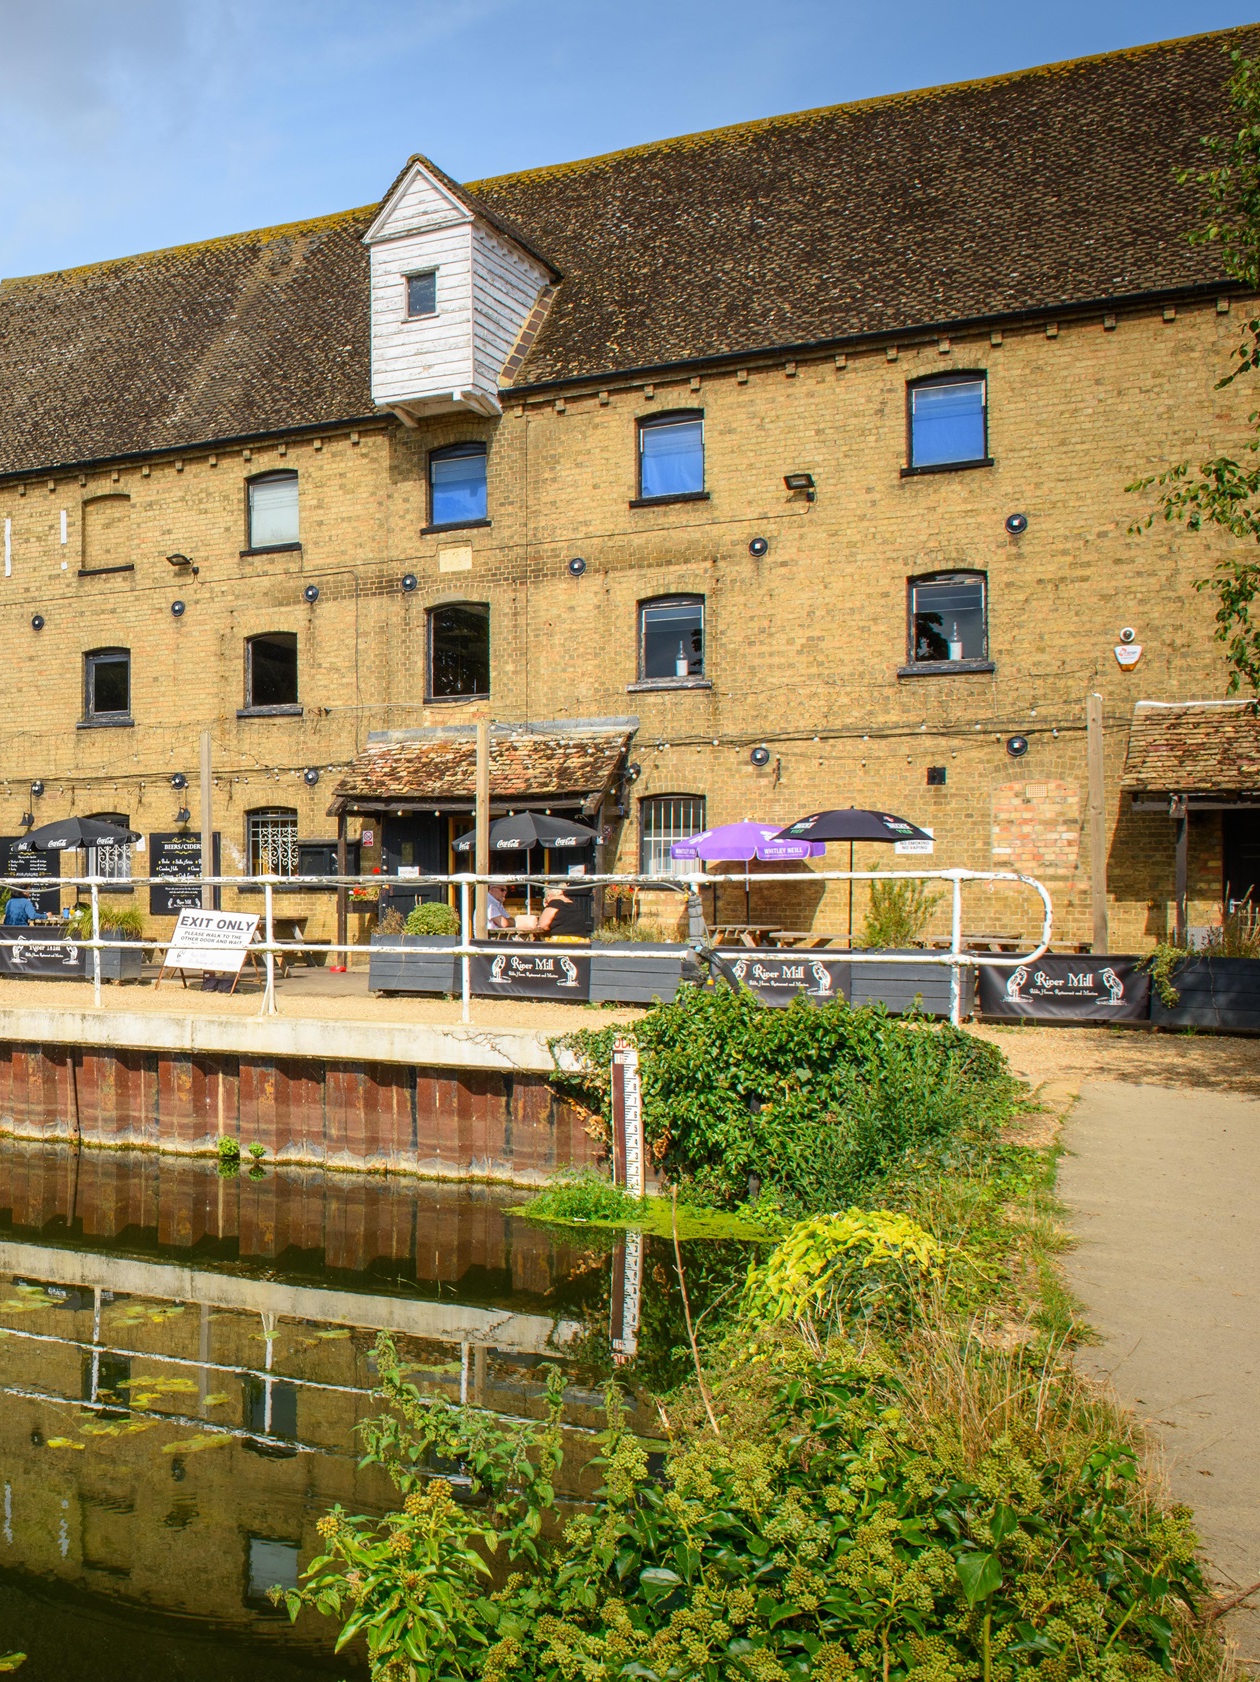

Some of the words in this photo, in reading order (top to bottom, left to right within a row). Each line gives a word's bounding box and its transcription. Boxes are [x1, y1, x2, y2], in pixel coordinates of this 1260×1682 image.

[48, 839, 67, 848] Coca-Cola
[97, 836, 115, 845] Coca-Cola
[497, 839, 521, 848] Coca-Cola
[555, 836, 577, 846] Coca-Cola
[180, 916, 213, 928] EXIT
[216, 919, 255, 931] ONLY
[510, 956, 533, 971] River
[534, 958, 555, 970] Mill
[752, 963, 780, 980] River
[781, 965, 805, 979] Mill
[1034, 970, 1065, 988] River
[1067, 972, 1094, 987] Mill
